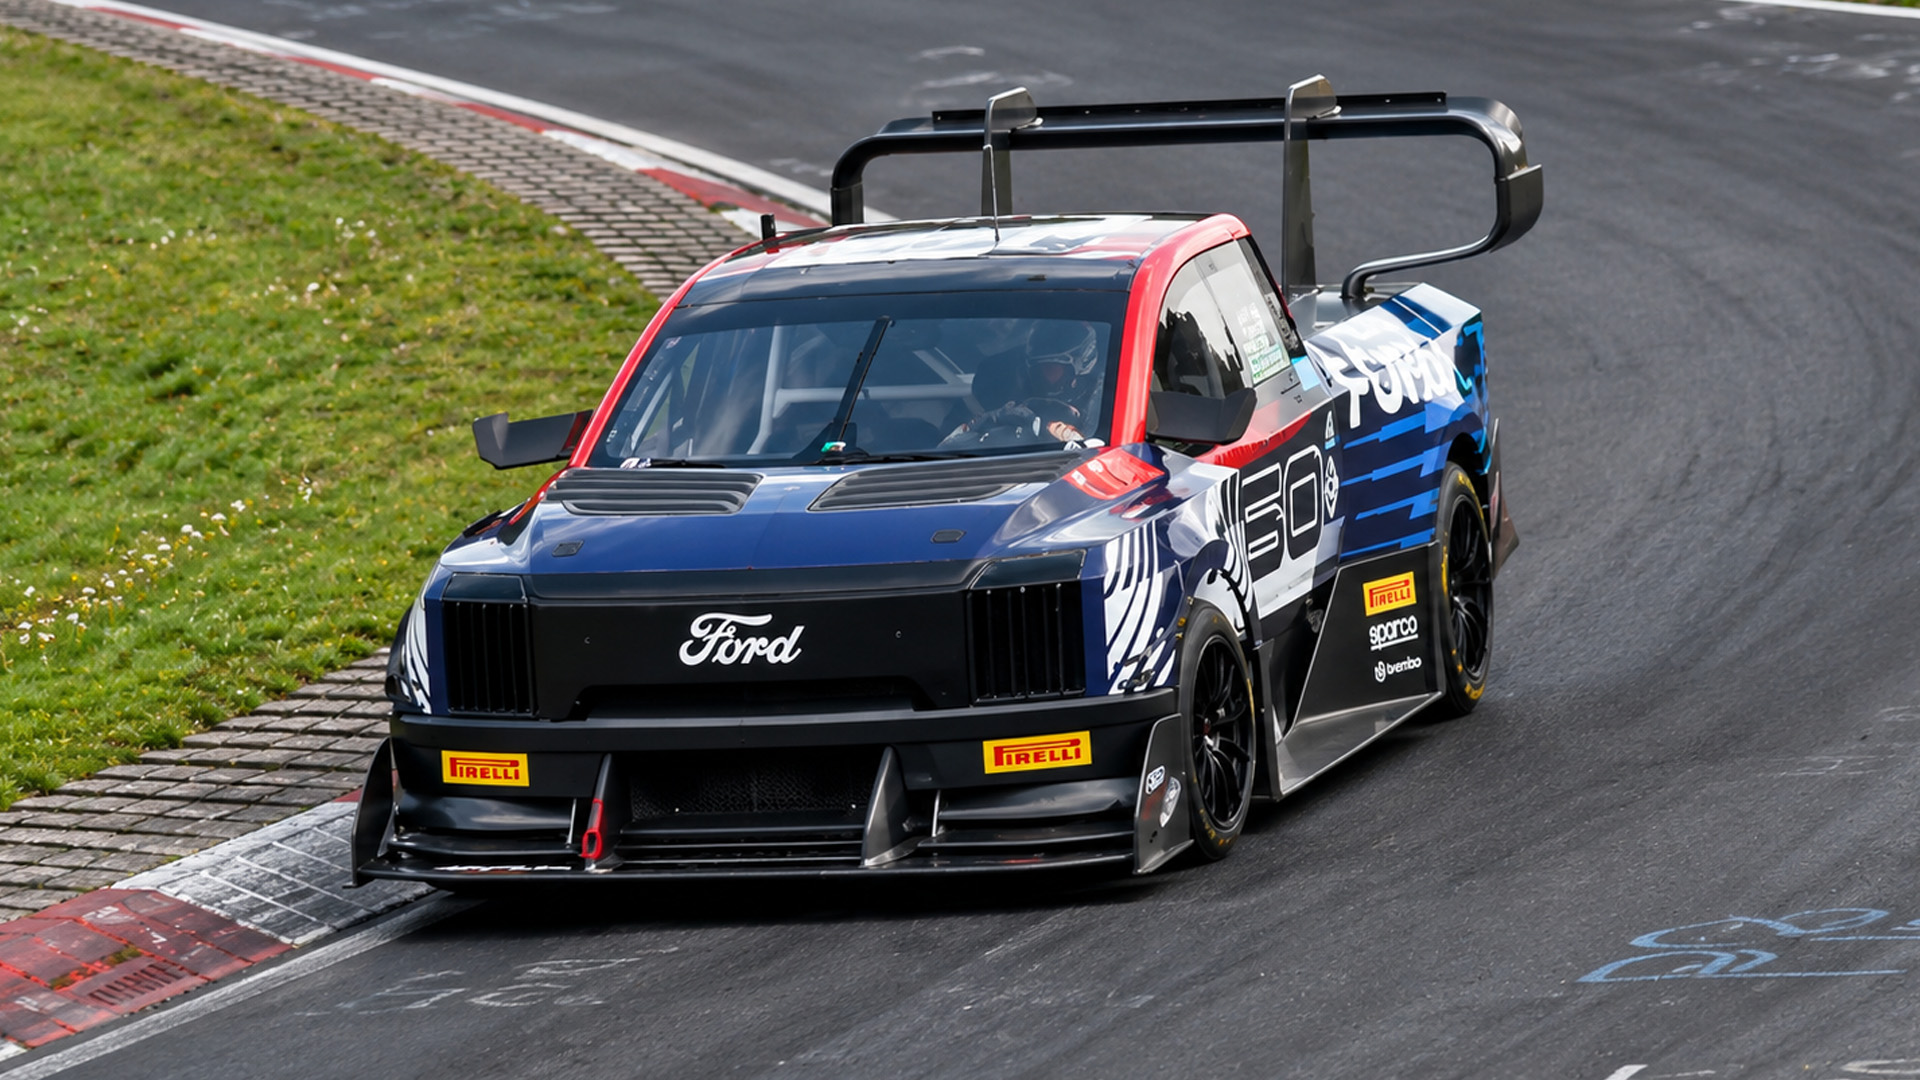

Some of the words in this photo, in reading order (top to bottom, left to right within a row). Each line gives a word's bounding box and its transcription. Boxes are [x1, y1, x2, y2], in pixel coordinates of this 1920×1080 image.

[1369, 579, 1411, 608] PIRELLI
[679, 612, 805, 666] Ford
[1369, 615, 1418, 650] sparco
[993, 738, 1081, 767] PIRELLI
[449, 757, 520, 780] PIRELLI
